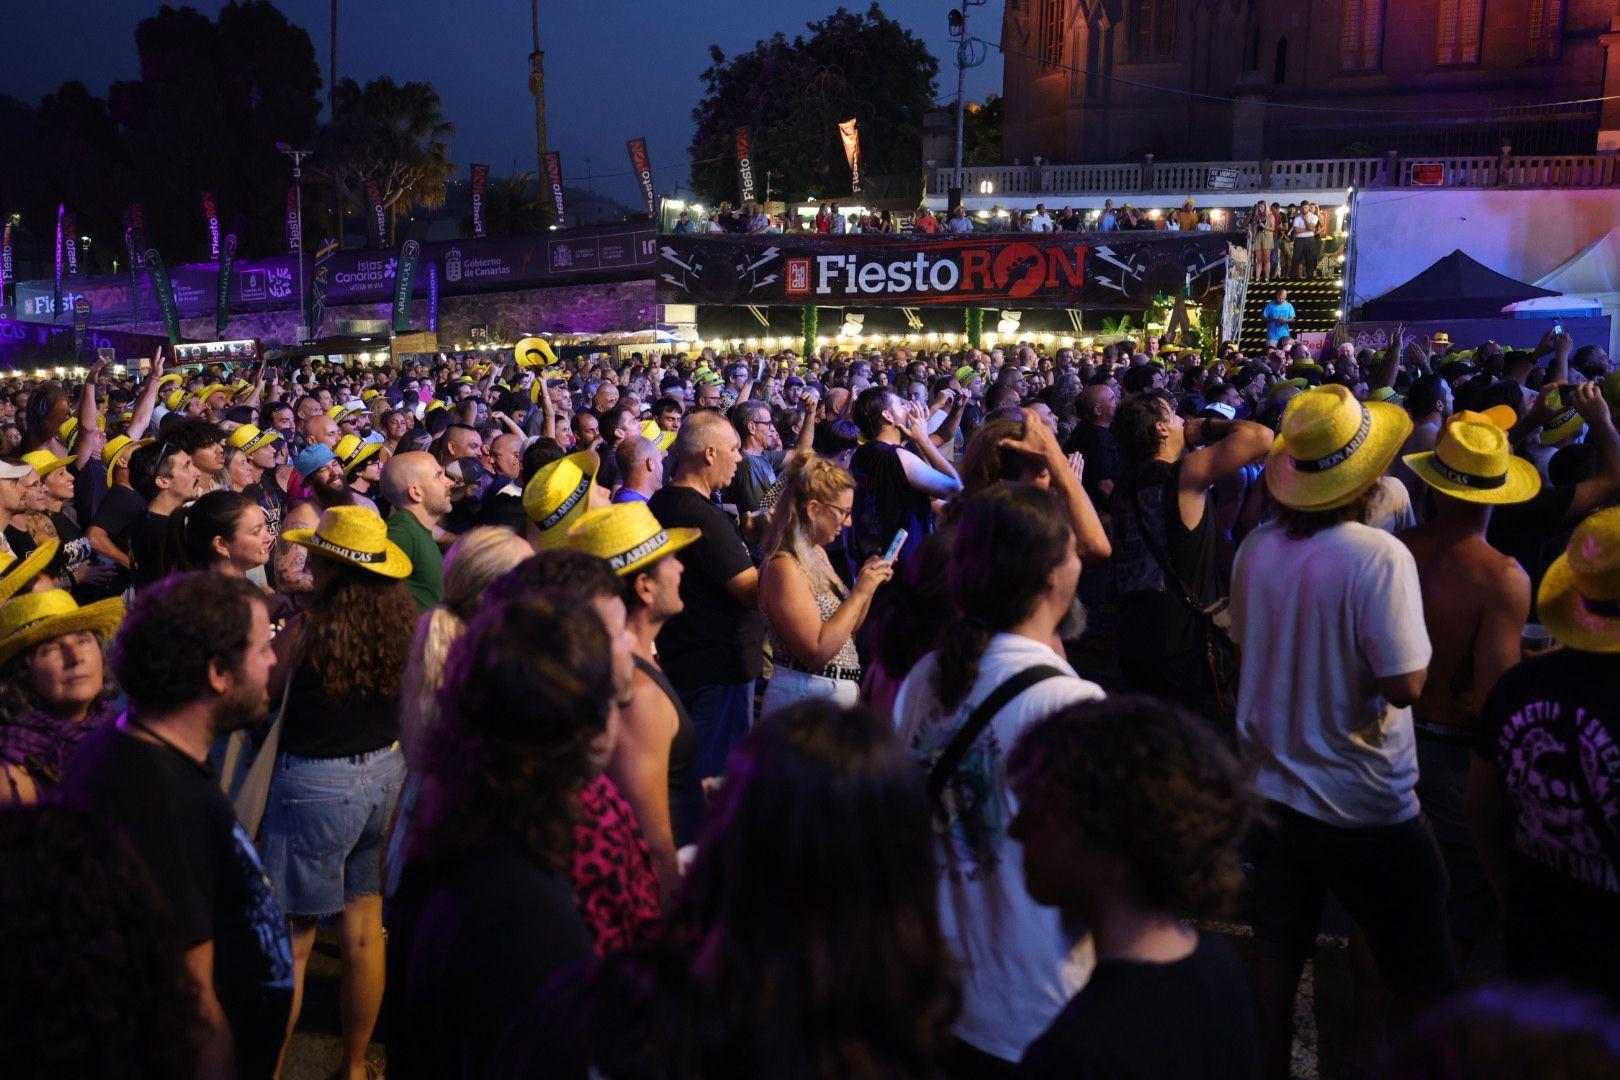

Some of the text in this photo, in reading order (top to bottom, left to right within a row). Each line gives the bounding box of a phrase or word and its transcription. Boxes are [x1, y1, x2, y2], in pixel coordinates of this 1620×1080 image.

[358, 260, 383, 271] Islas
[464, 257, 501, 268] Gobierno
[335, 270, 383, 283] Canarias
[475, 266, 511, 276] Canarias
[398, 261, 412, 314] AREHUCAS
